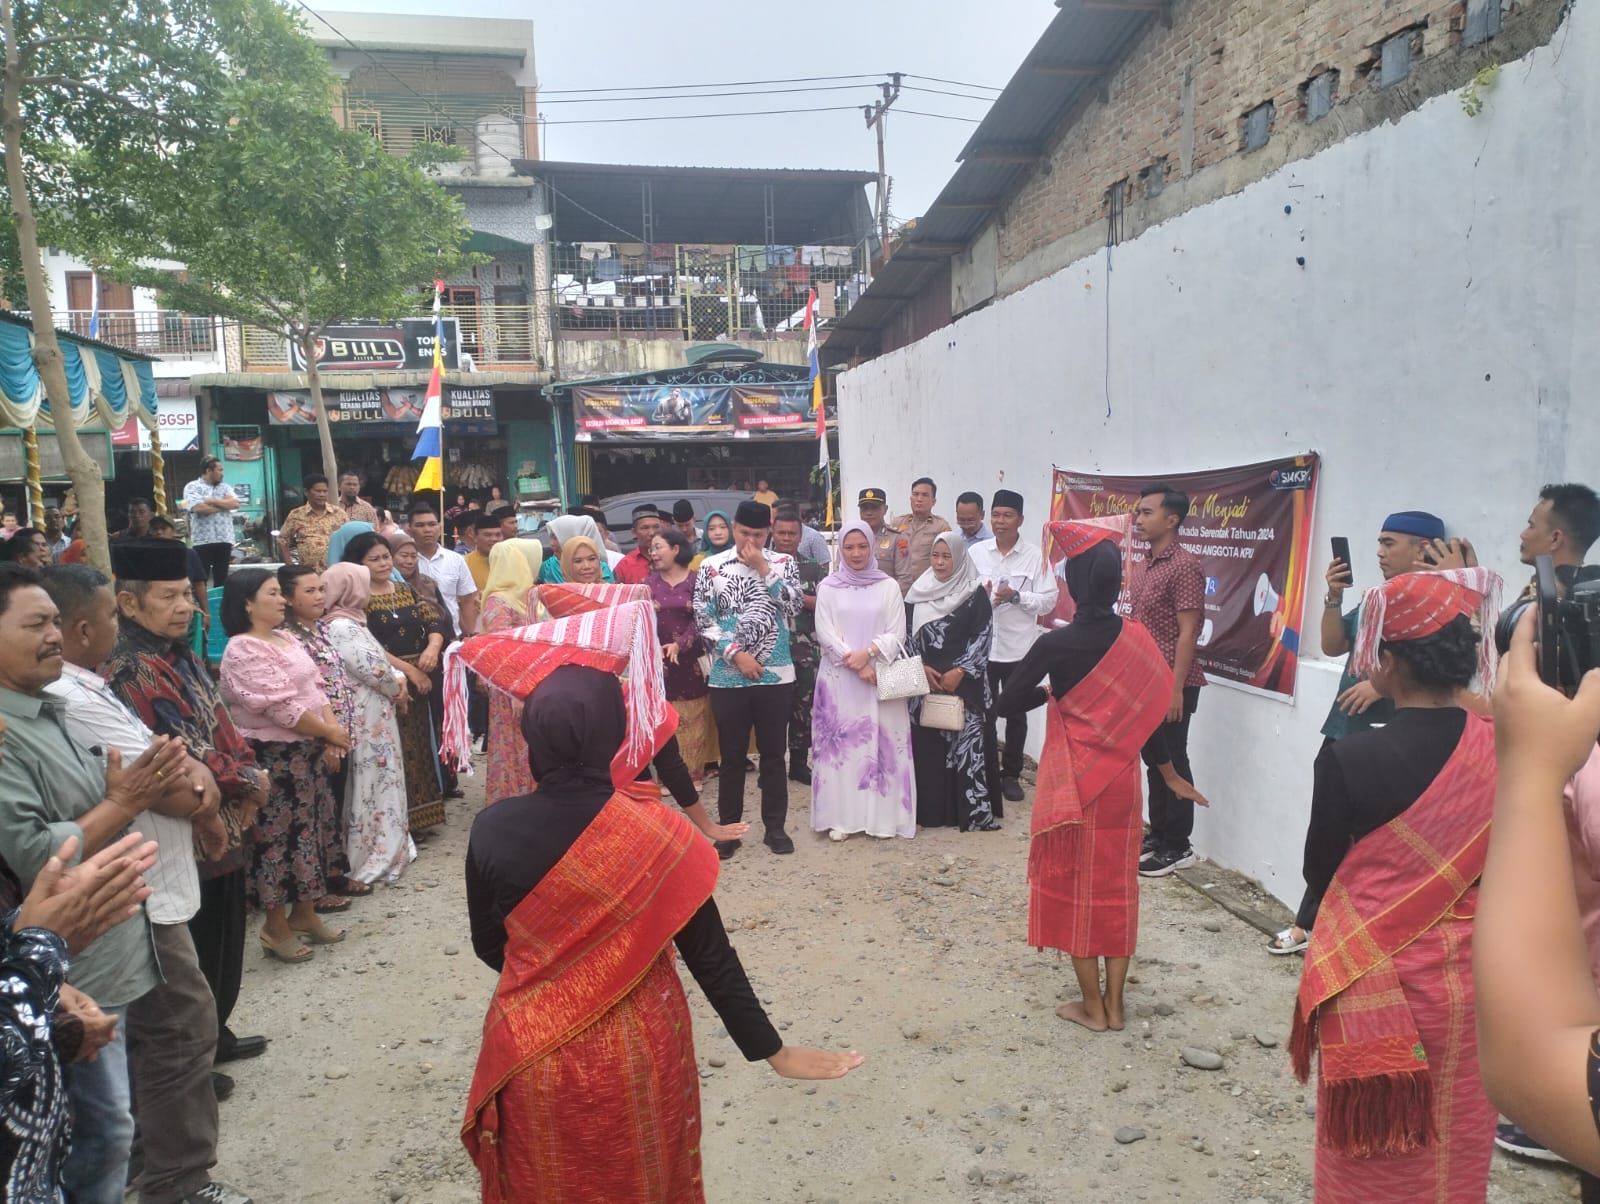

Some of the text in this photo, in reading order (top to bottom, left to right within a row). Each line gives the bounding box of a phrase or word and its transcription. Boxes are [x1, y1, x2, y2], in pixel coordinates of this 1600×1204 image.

[416, 337, 446, 345] TOK
[331, 341, 399, 356] BULL
[340, 391, 381, 402] KUALITAS
[451, 389, 490, 400] KUALITAS
[340, 410, 383, 420] BULL
[451, 408, 492, 418] BULL
[1202, 493, 1251, 527] Menjadi
[1200, 527, 1230, 539] Serentak
[1231, 528, 1257, 540] Tahun
[1257, 528, 1275, 540] 2024
[1202, 544, 1240, 558] ANGGOTA
[1240, 547, 1255, 558] KPU
